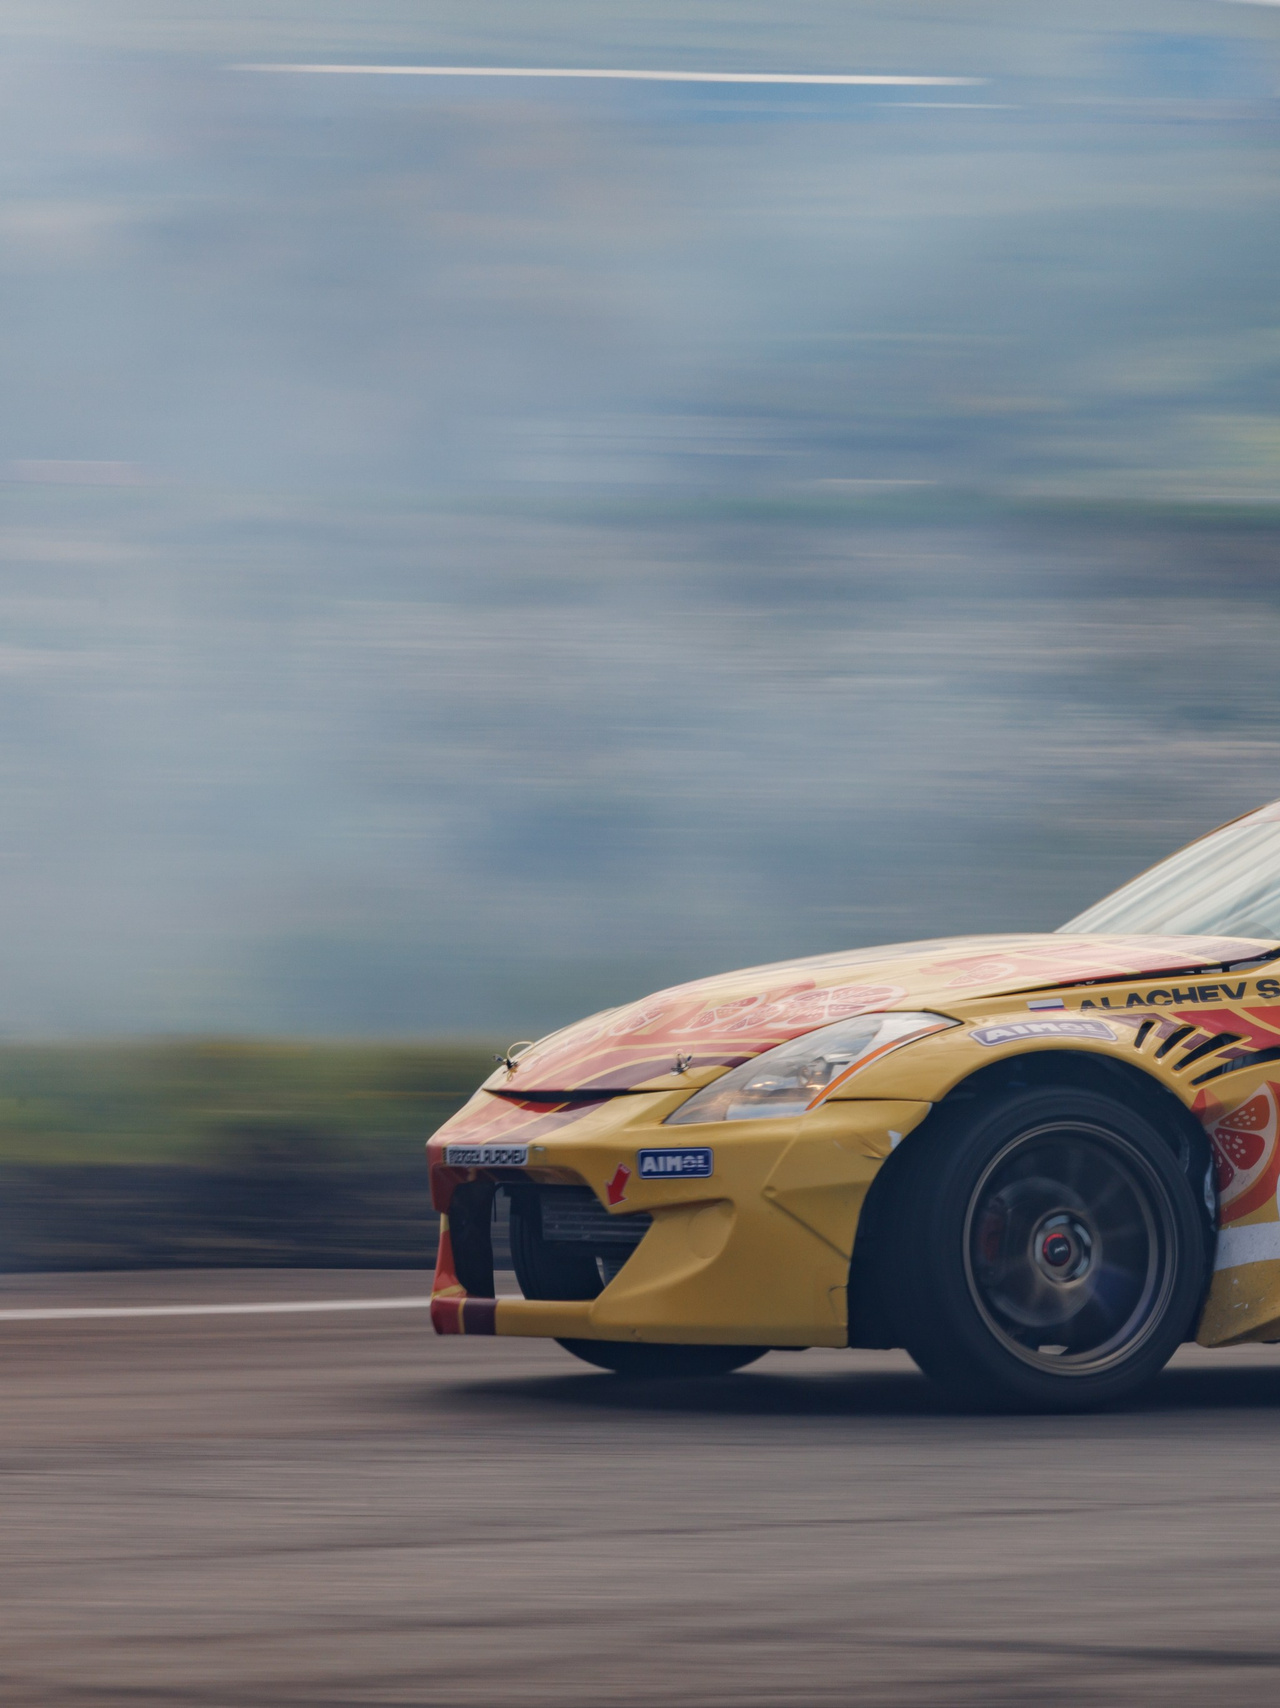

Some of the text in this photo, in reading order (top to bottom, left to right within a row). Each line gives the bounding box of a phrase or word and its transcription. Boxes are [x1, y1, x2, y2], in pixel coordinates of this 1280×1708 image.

[1080, 981, 1247, 1013] ALACHEV
[985, 1022, 1110, 1042] AIMOL
[641, 1155, 709, 1173] AIMOL
